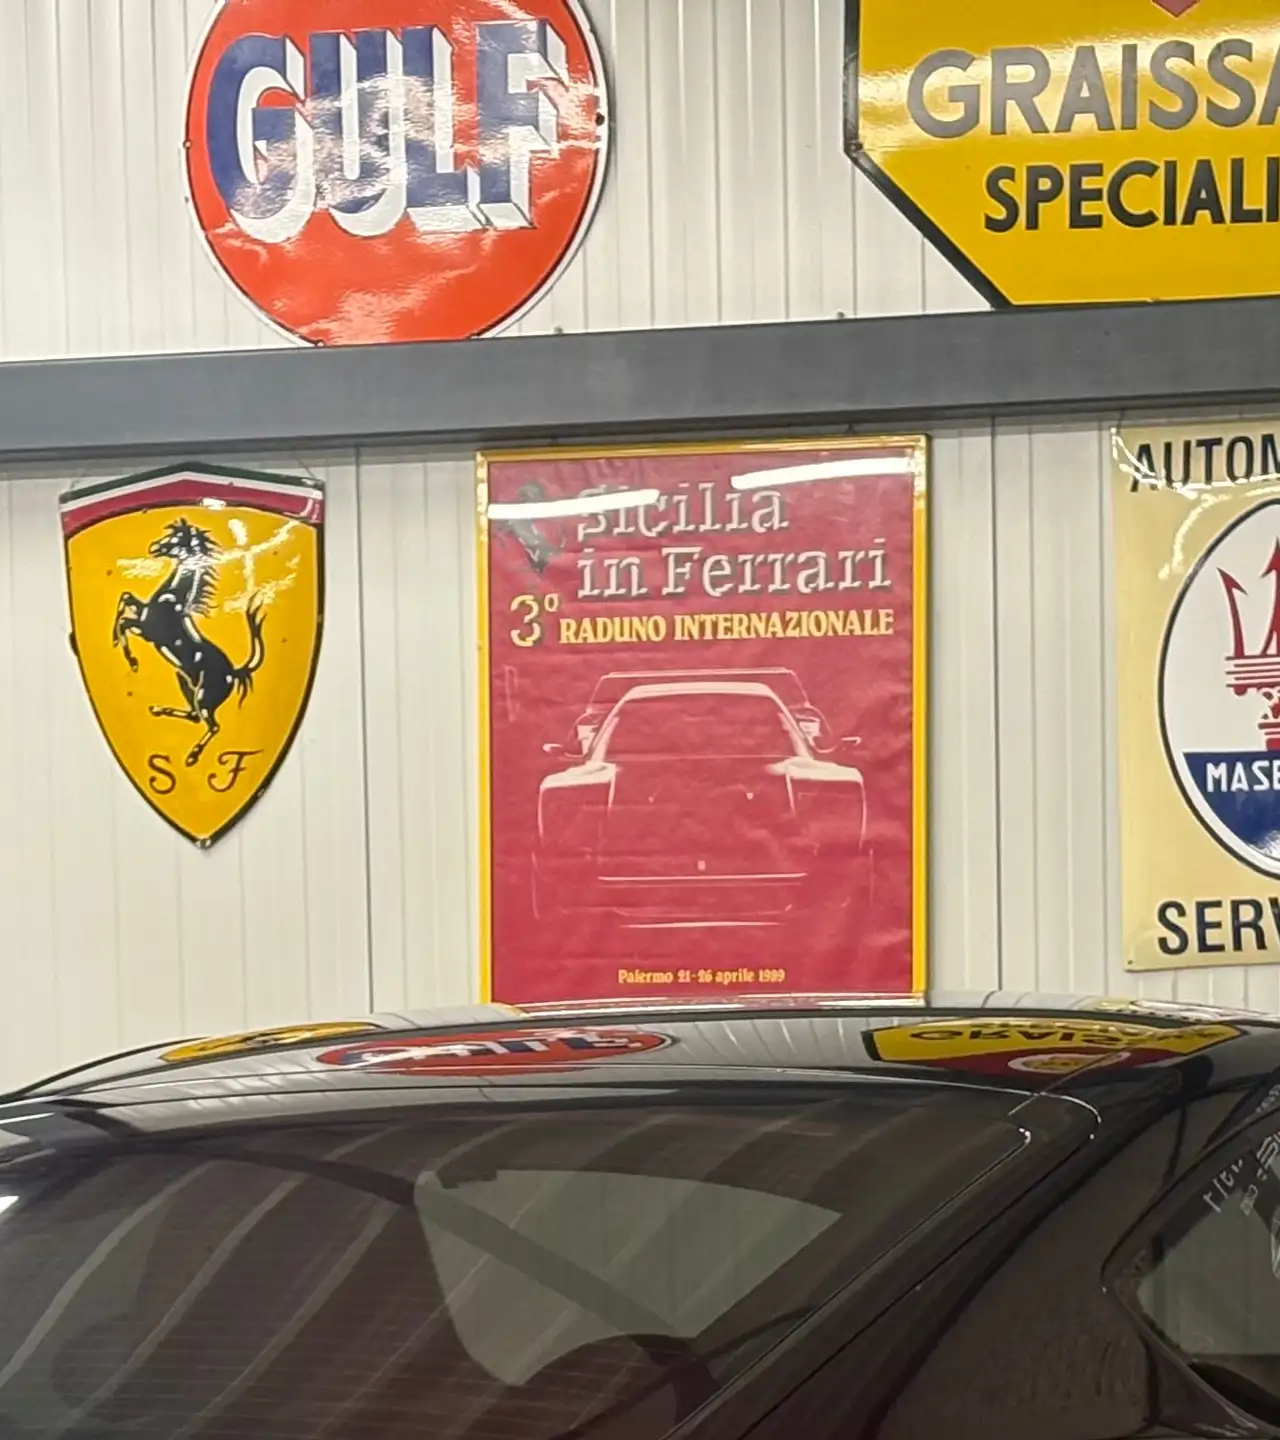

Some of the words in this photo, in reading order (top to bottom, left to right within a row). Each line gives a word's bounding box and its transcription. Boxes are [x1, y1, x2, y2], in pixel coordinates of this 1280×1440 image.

[206, 19, 568, 242] GULF
[576, 482, 789, 541] Sicilia
[576, 547, 648, 599] in
[661, 538, 891, 598] Ferrari
[559, 615, 666, 645] RADUNO
[674, 609, 894, 641] INTERNAZIONALE
[148, 753, 176, 795] S
[207, 749, 264, 793] F
[618, 969, 673, 983] Palermo
[715, 968, 755, 985] aprile
